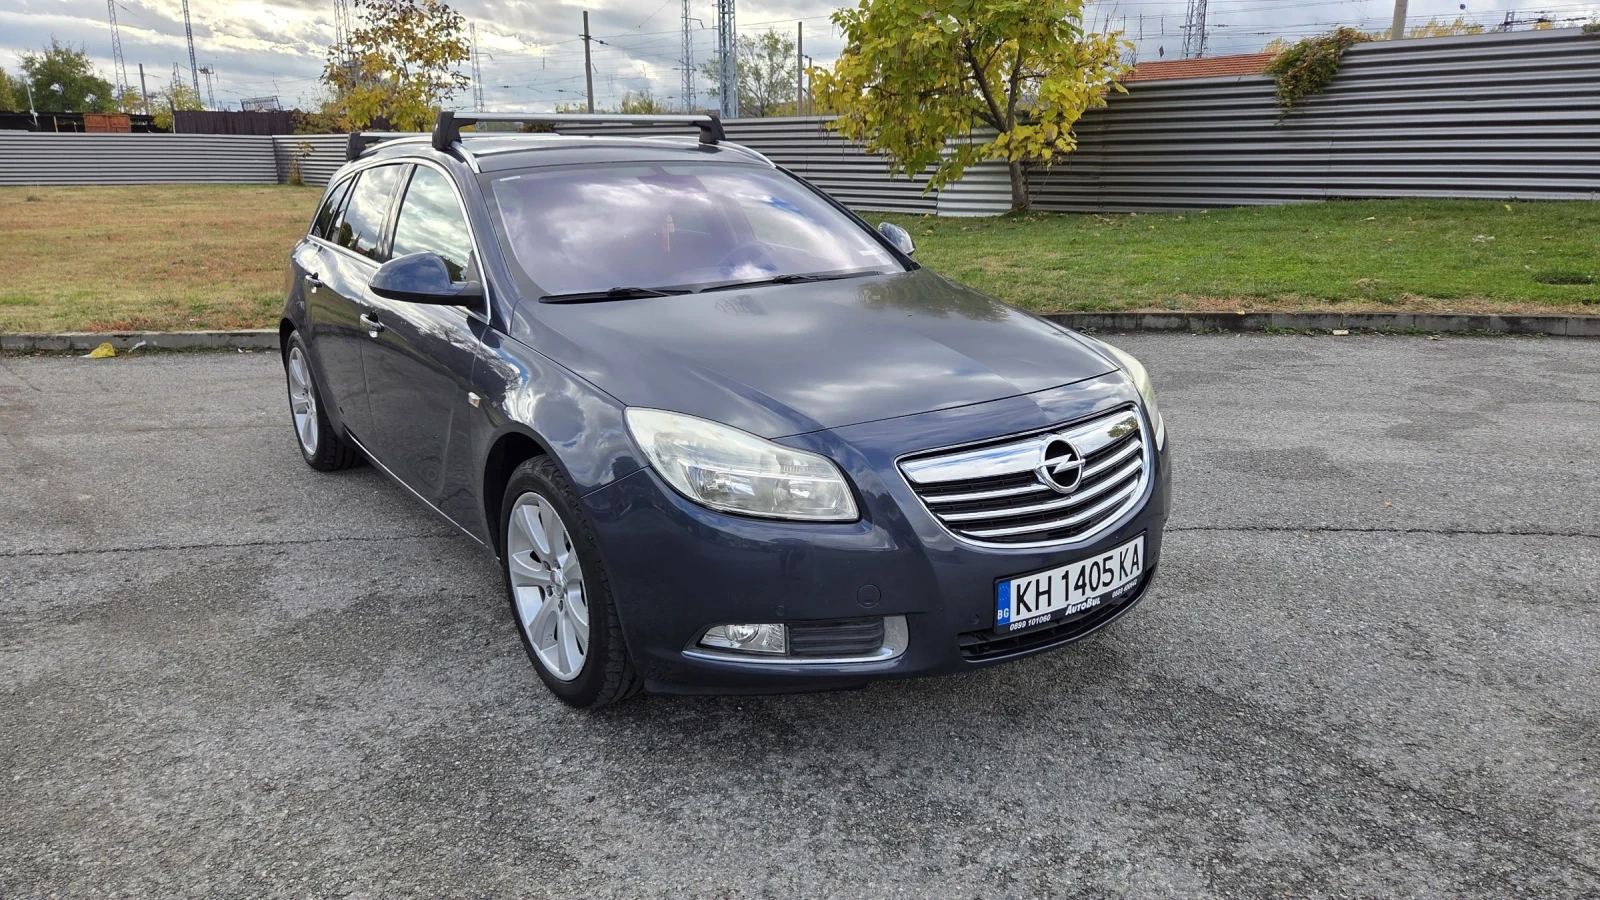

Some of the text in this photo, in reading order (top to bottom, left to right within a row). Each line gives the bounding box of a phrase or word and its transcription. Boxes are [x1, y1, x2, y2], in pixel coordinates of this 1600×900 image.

[1016, 543, 1140, 616] KH 1405 KA
[997, 608, 1010, 620] BG
